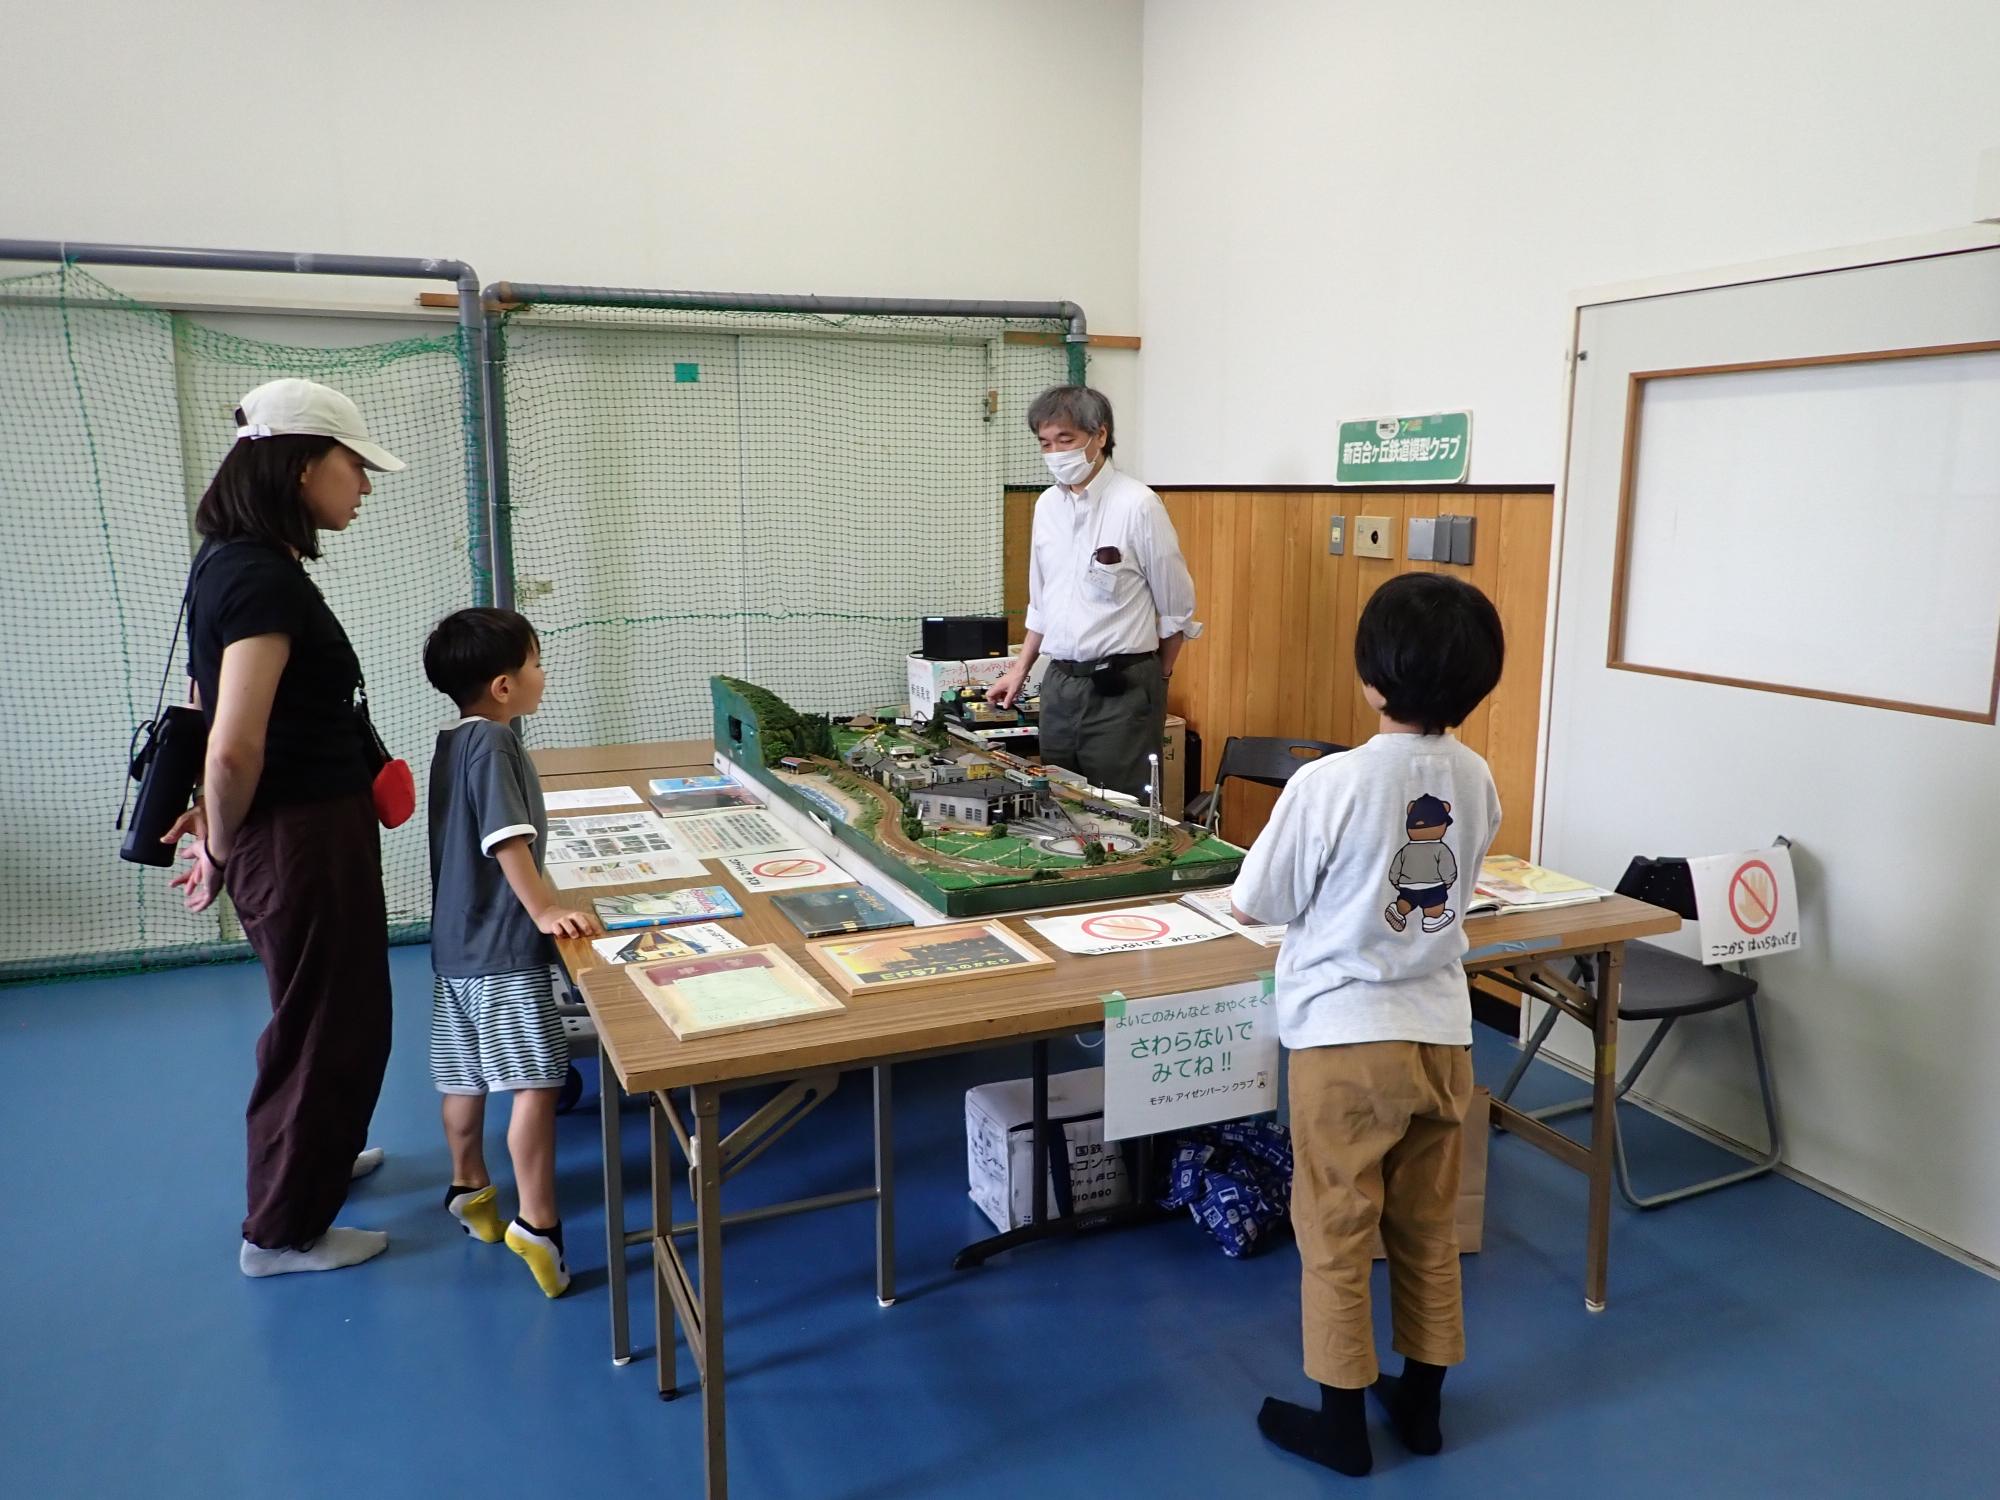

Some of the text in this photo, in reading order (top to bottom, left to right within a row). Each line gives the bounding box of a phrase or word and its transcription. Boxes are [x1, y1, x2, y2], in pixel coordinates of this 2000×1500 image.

[1711, 940, 1745, 957] ここから
[1115, 995, 1270, 1029] よいこのみんなと おやくそく
[1130, 1020, 1254, 1060] さわらないで
[1149, 1095, 1173, 1107] モデル
[1232, 1079, 1254, 1091] クラブ
